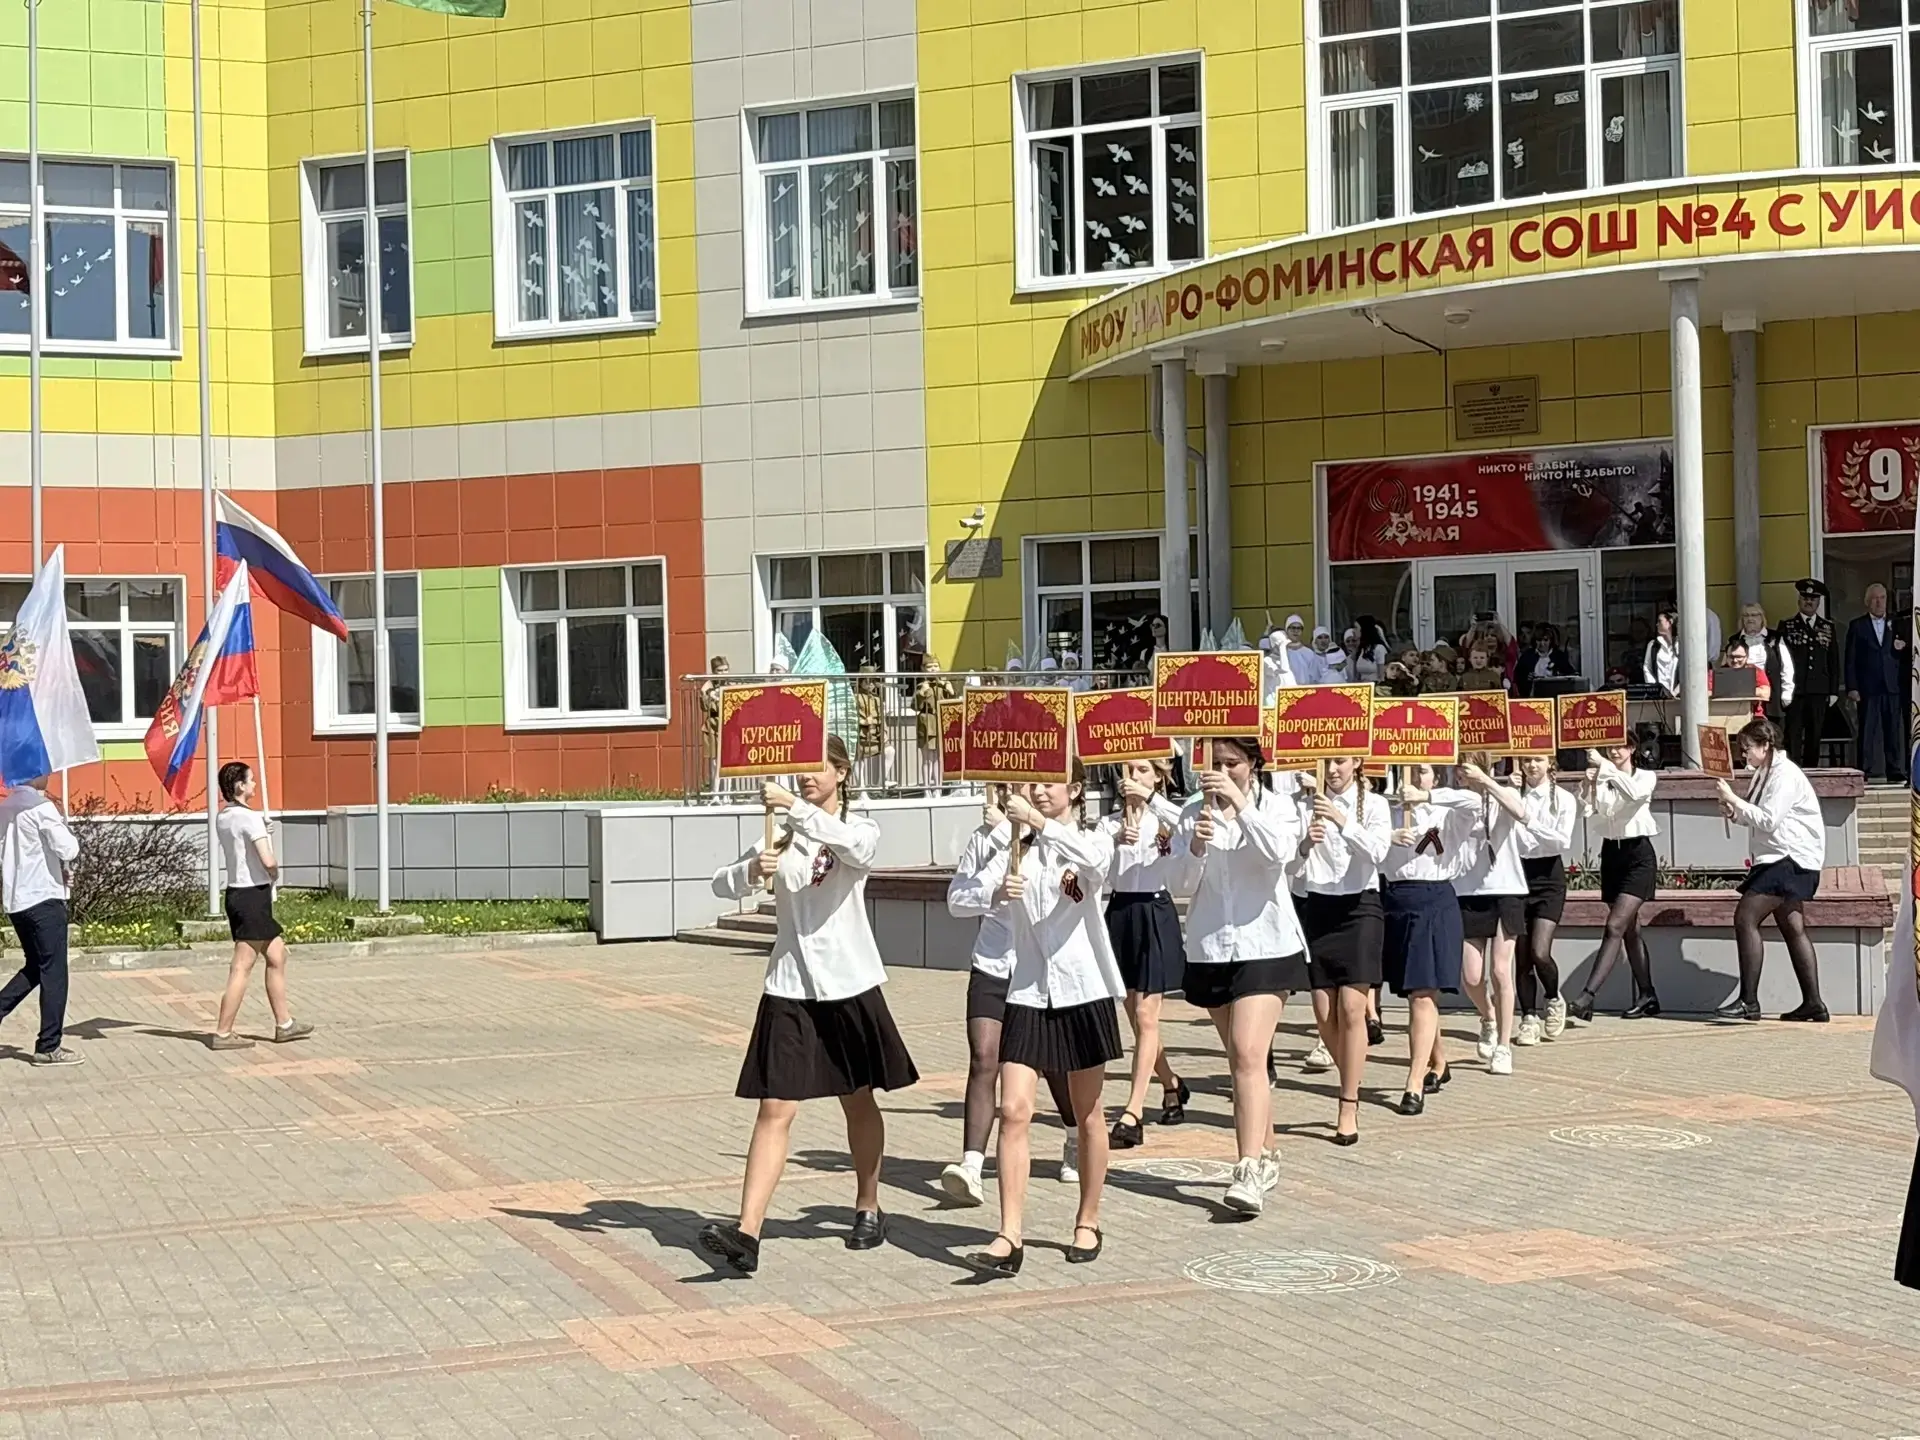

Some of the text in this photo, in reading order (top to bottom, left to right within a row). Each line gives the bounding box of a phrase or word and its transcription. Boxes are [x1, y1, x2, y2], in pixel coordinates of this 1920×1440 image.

[1081, 306, 1128, 360] МБОУ
[1509, 208, 1637, 263] СОШ
[1658, 198, 1756, 247] №4
[1768, 193, 1806, 237] С
[1821, 188, 1920, 233] УИ
[1478, 460, 1578, 475] НИКТО НЕ ЗАБЫТ,
[1524, 466, 1636, 482] НИЧТО НЕ ЗАБЫТО!
[1868, 447, 1903, 501] 9
[1424, 500, 1479, 520] 1945
[1417, 525, 1460, 542] МАЯ
[1157, 688, 1258, 710] ЦЕНТРАЛЬНЫЙ
[1586, 700, 1597, 714] 3
[1183, 708, 1230, 725] ФРОНТ
[1459, 701, 1471, 716] 2
[1278, 716, 1369, 733] ВОРОНЕЖСКИЙ
[1458, 715, 1504, 731] РУССКИЙ
[1563, 713, 1621, 730] БЕЛОРУССКИЙ
[741, 719, 802, 745] КУРСКИЙ
[1373, 725, 1454, 741] РИБАЛТИЙСКИЙ
[1458, 731, 1486, 744] РОНТ
[1512, 723, 1552, 737] АПАДНЫЙ
[1577, 727, 1607, 740] ФРОНТ
[972, 727, 1058, 751] КАРЕЛЬСКИЙ
[1103, 737, 1145, 753] ФРОНТ
[1301, 732, 1344, 747] ФРОНТ
[1511, 736, 1532, 749] ОНТ
[747, 744, 794, 764] ФРОНТ
[1389, 741, 1430, 755] ФРОНТ
[991, 751, 1037, 771] ФРОНТ
